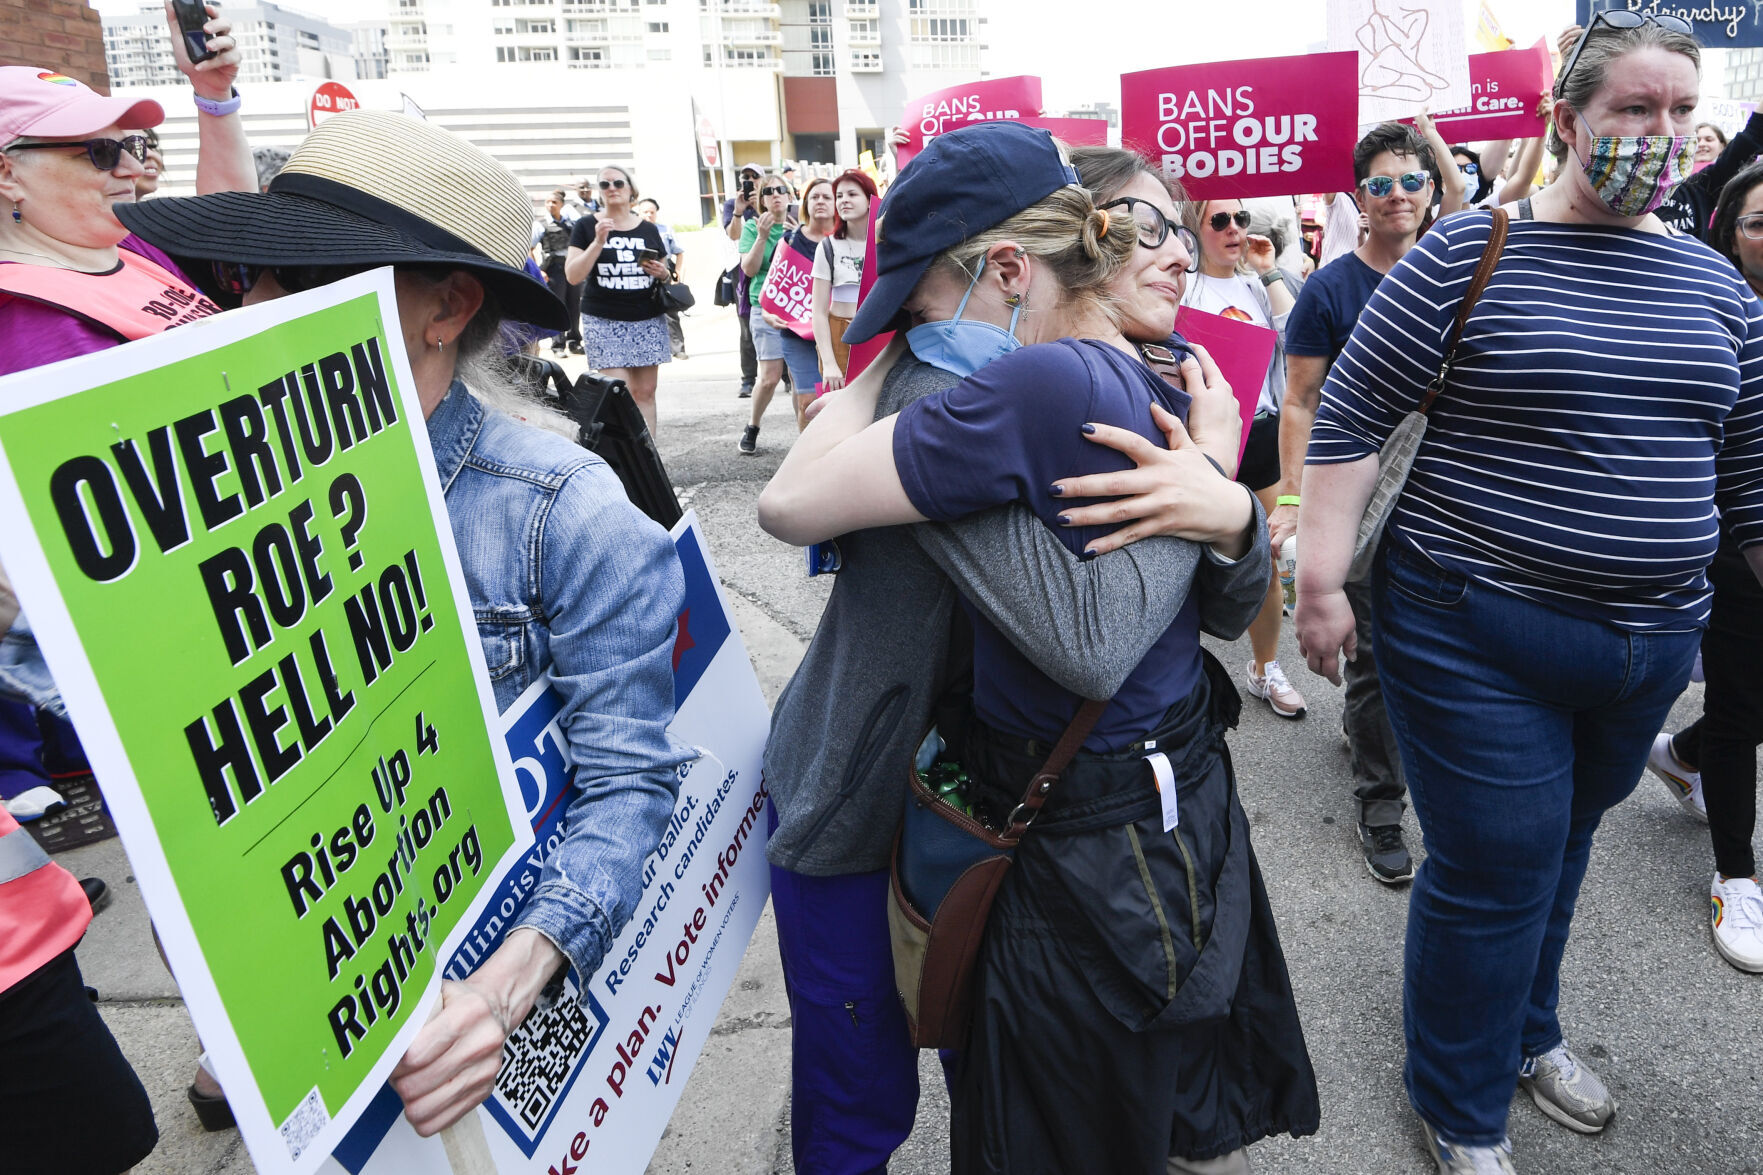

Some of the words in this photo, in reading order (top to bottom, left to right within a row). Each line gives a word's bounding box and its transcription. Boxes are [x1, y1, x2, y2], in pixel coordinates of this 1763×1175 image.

[316, 93, 331, 108] DO
[336, 96, 356, 111] NOT
[1158, 86, 1254, 121] BANS
[1476, 97, 1524, 111] Care.
[1487, 79, 1498, 92] is
[922, 95, 980, 118] BANS
[1157, 120, 1227, 151] OFF
[1233, 114, 1318, 146] OUR
[1162, 144, 1303, 179] BODIES
[603, 237, 645, 250] LOVE
[616, 250, 635, 262] IS
[768, 266, 792, 290] OFF
[774, 252, 812, 288] BANS
[764, 282, 813, 324] ODIES
[50, 336, 399, 583] OVERTURN
[184, 628, 356, 828] HELL
[343, 548, 436, 687] NO!
[280, 803, 376, 920] Rise
[371, 748, 412, 814] Up
[415, 711, 439, 756] 4
[657, 795, 699, 861] ballot.
[322, 786, 453, 983] Abortion
[605, 882, 675, 996] Research
[674, 769, 739, 880] candidates.
[327, 824, 484, 1061] Rights.org
[674, 981, 696, 1024] LEAGUE
[701, 931, 723, 969] WOMEN
[720, 894, 740, 930] VOTERS
[589, 1097, 609, 1127] a
[606, 1005, 661, 1098] plan.
[654, 907, 706, 987] Vote
[645, 1025, 677, 1088] LWV
